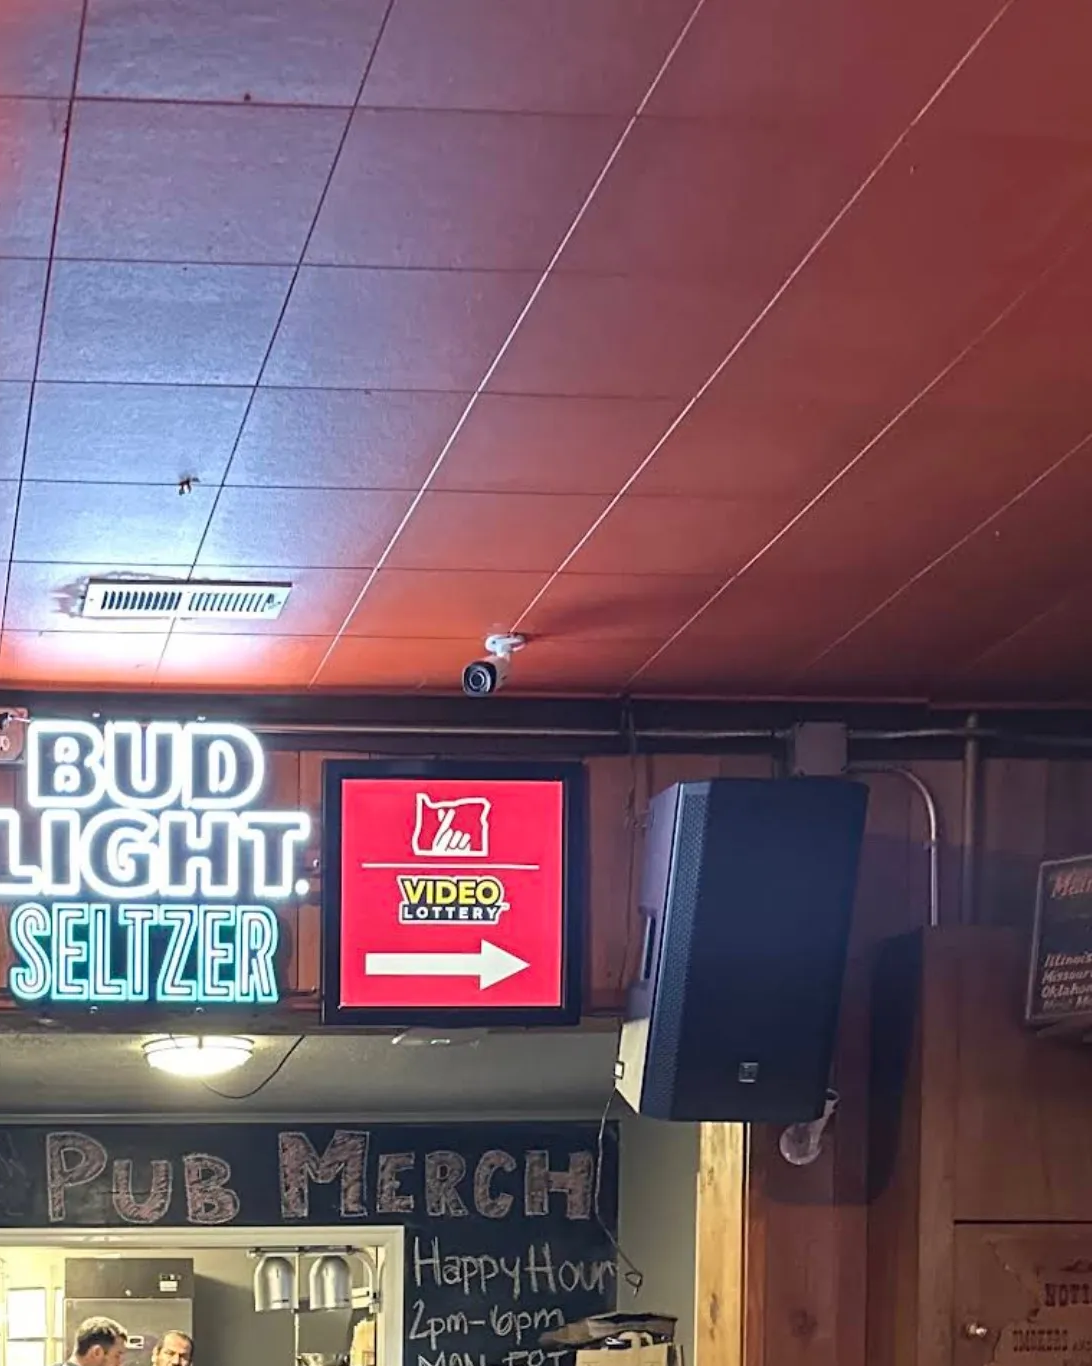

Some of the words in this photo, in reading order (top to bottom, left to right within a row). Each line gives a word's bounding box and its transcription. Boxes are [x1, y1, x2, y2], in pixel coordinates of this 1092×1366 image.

[27, 719, 265, 809] BUD
[401, 878, 501, 905] VIDEO
[402, 905, 500, 920] LOTTERY
[10, 902, 279, 1003] SELTZER
[413, 1236, 522, 1300] Happy
[524, 1241, 618, 1295] Hour
